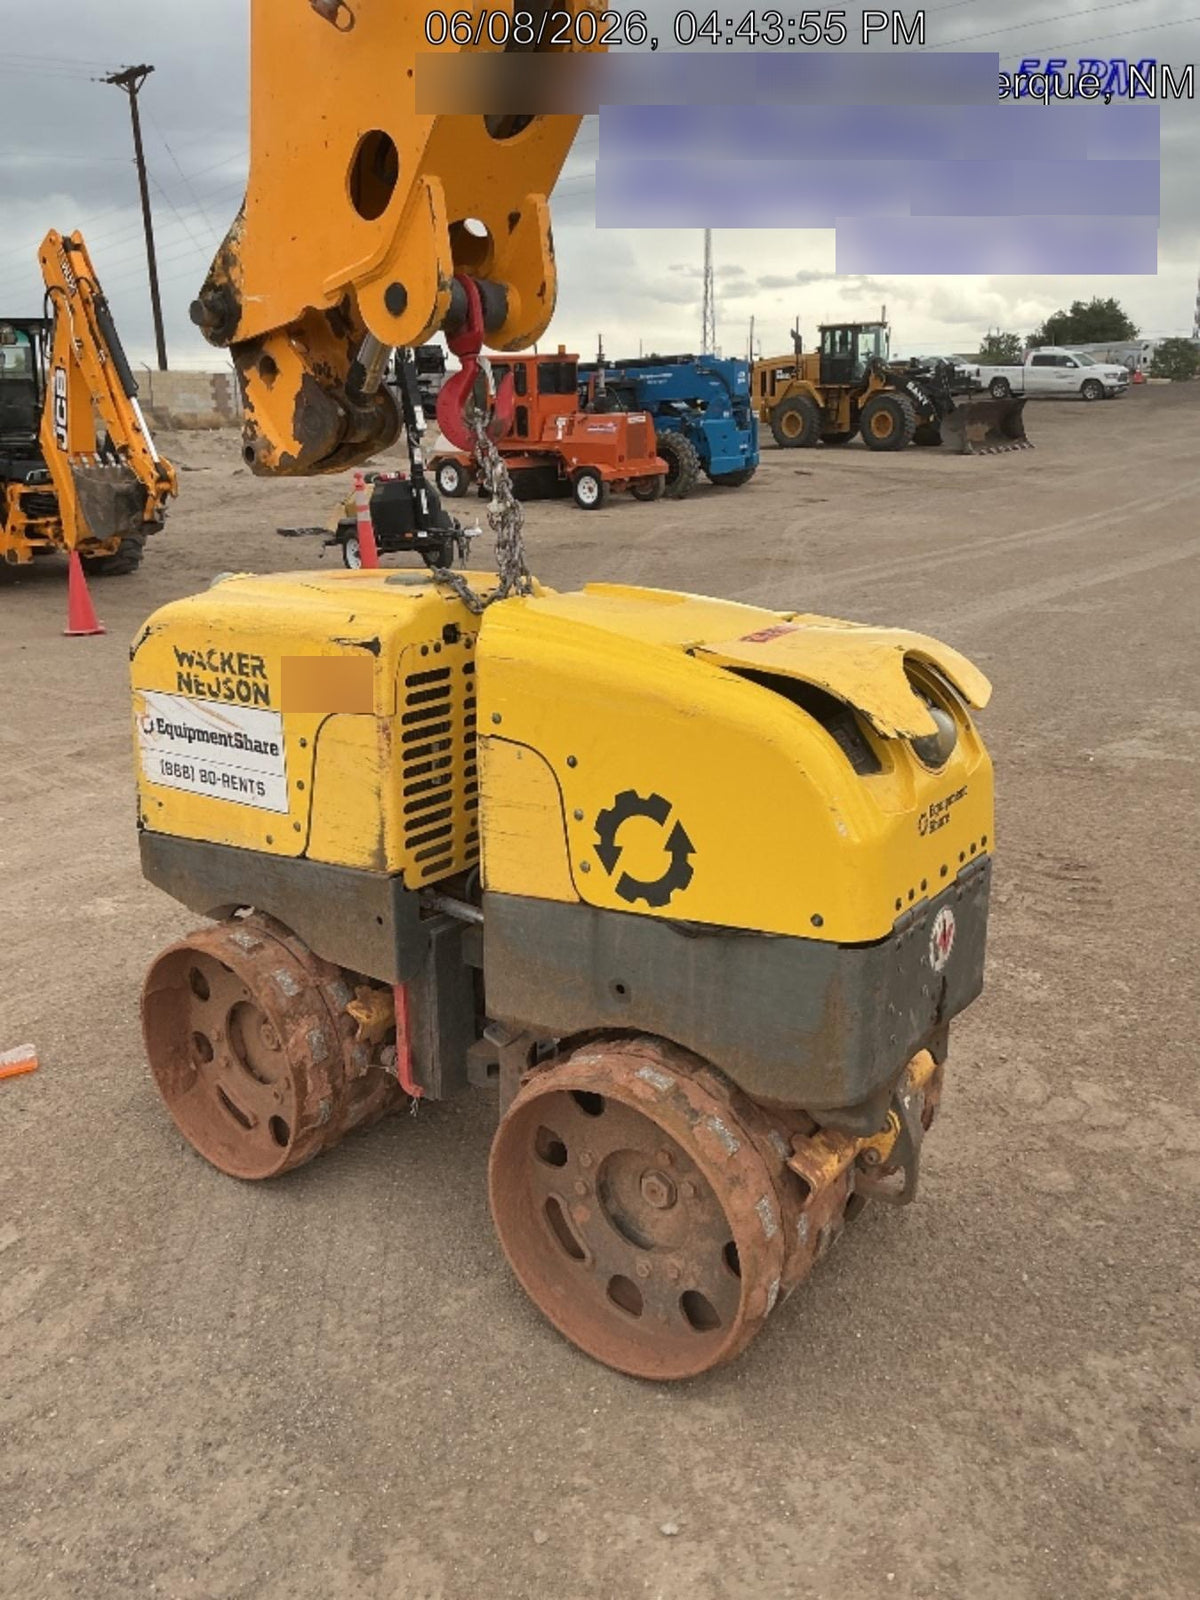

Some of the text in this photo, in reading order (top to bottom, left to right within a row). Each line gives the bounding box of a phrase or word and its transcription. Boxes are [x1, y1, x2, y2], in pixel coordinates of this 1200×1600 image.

[54, 366, 67, 450] JCB
[173, 645, 267, 679] WACKER
[176, 671, 271, 706] NEUSON
[156, 717, 279, 756] EquipmentShare
